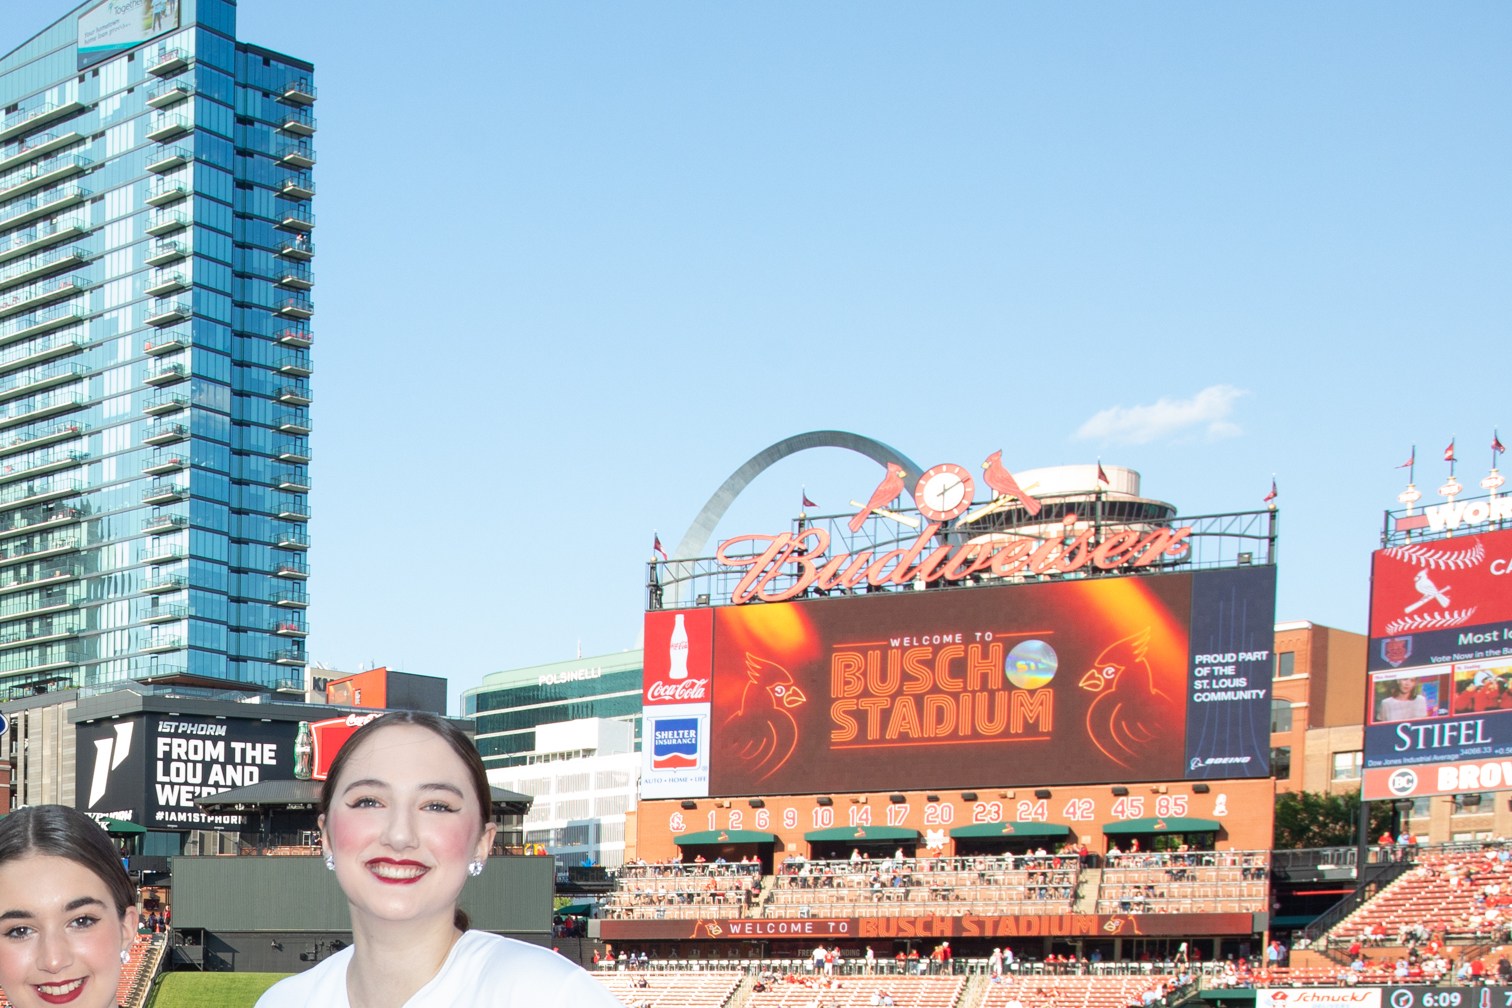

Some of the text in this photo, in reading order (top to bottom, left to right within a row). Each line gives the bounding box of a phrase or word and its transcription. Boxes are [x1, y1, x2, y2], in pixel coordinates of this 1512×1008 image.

[717, 513, 1192, 605] Budweiser
[890, 631, 993, 647] WELCOME TO
[1458, 630, 1499, 645] Most
[1195, 651, 1269, 664] PROUD PART
[1430, 649, 1502, 663] Vote Now in the
[538, 666, 601, 687] POLSINELLI
[832, 643, 1003, 698] BUSCH
[1194, 665, 1236, 677] OF THE
[647, 679, 709, 701] Coca-Cola
[1193, 678, 1247, 689] ST. LOUIS
[1193, 689, 1266, 702] COMMUNITY
[830, 688, 1054, 741] STADIUM
[158, 721, 227, 736] 1ST PHORM
[656, 730, 696, 740] SHELTER
[656, 737, 696, 746] INSURANCE
[157, 737, 277, 765] FROM THE
[1205, 756, 1251, 764] BOEING
[1367, 759, 1382, 767] Dow
[1403, 755, 1432, 763] Industrial
[1432, 753, 1460, 762] Average
[156, 760, 260, 786] LOU AND
[1394, 775, 1414, 789] BC
[708, 795, 1188, 831] 1 2 6 9 10 14 17 20 23 24 42 45 85
[729, 914, 1098, 937] WELCOME TO BUSCH STADIUM
[1293, 992, 1372, 1002] Schnucks
[1422, 992, 1462, 1007] 6:09
